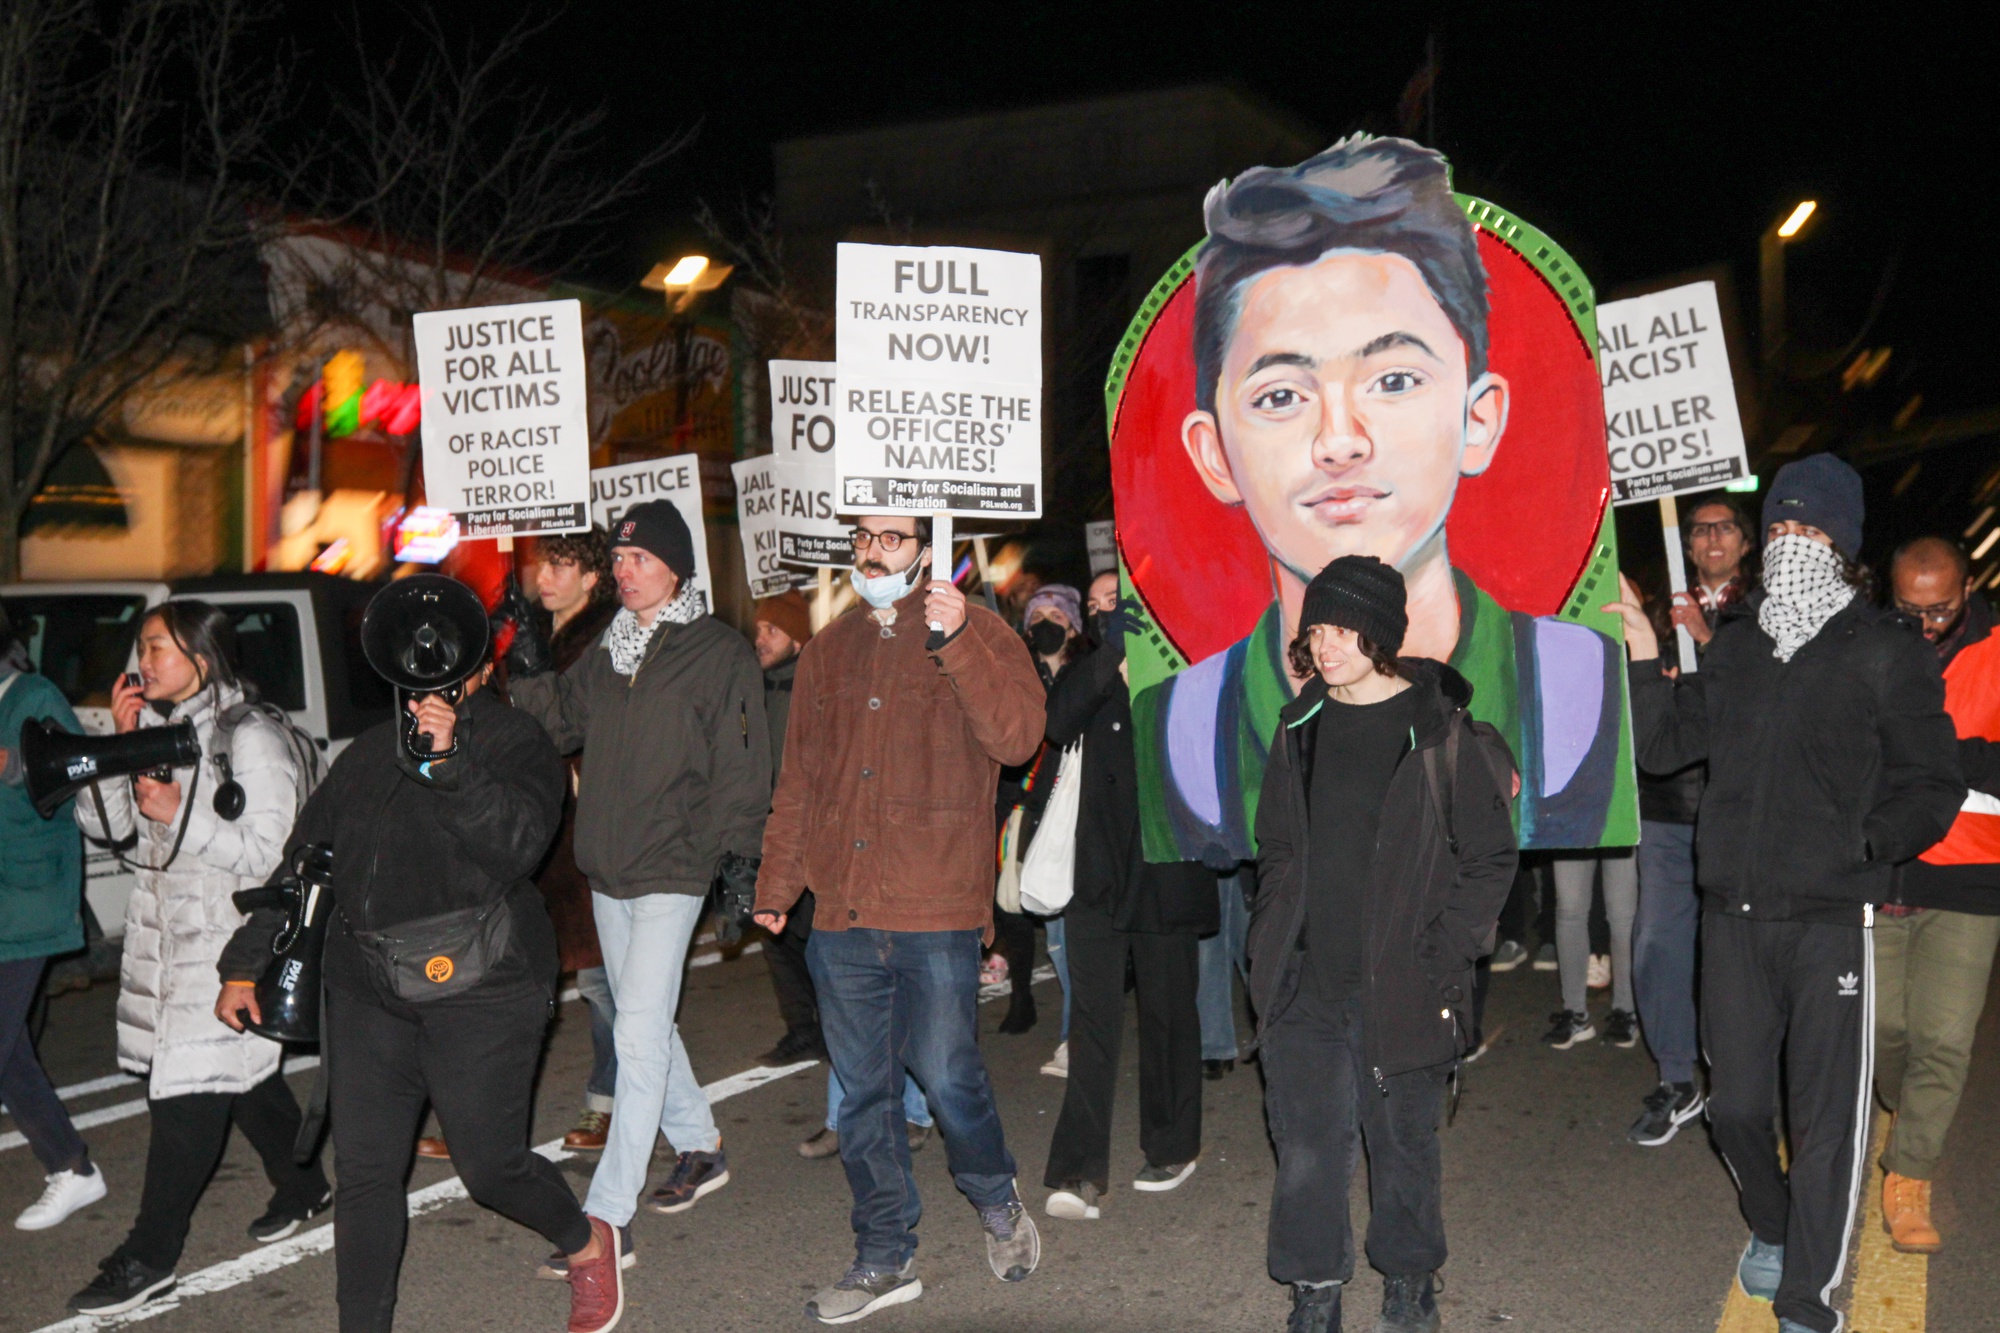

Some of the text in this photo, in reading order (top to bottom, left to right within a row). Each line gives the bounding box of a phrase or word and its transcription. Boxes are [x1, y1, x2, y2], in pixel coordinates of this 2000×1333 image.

[894, 260, 989, 297] FULL
[850, 301, 1029, 327] TRANSPARENCY
[445, 315, 554, 352] JUSTICE
[1598, 307, 1708, 353] AIL ALL
[888, 333, 990, 365] NOW!
[445, 348, 561, 383] FOR ALL
[1602, 341, 1699, 387] ACIST
[443, 381, 560, 415] VICTIMS
[778, 376, 836, 406] JUST
[848, 390, 1031, 422] RELEASE THE
[1607, 395, 1716, 441] KILLER
[449, 426, 561, 454] OF RACIST
[791, 413, 836, 453] FO
[867, 416, 1012, 447] OFFICERS'
[885, 444, 996, 474] NAMES!
[1609, 429, 1713, 474] COPS!
[469, 454, 544, 479] POLICE
[1626, 459, 1731, 489] Party for Socialism and
[462, 480, 555, 507] TERROR!
[590, 466, 690, 503] JUSTICE
[742, 471, 775, 495] JAIL
[846, 485, 877, 504] PSL
[888, 479, 1021, 498] Party for Socialism and
[1628, 484, 1673, 499] Liberation
[468, 504, 574, 524] Party for Socialism and
[745, 492, 776, 517] RAC
[780, 488, 836, 520] FAIS
[888, 494, 947, 508] Liberation
[980, 500, 1022, 511] PSLweb.org
[468, 523, 513, 536] Liberation
[754, 529, 776, 552] KI
[797, 537, 852, 551] Party for Social
[758, 553, 780, 574] CO
[797, 549, 830, 561] Liberation
[66, 760, 96, 777] PYLE
[283, 960, 302, 991] PYLE
